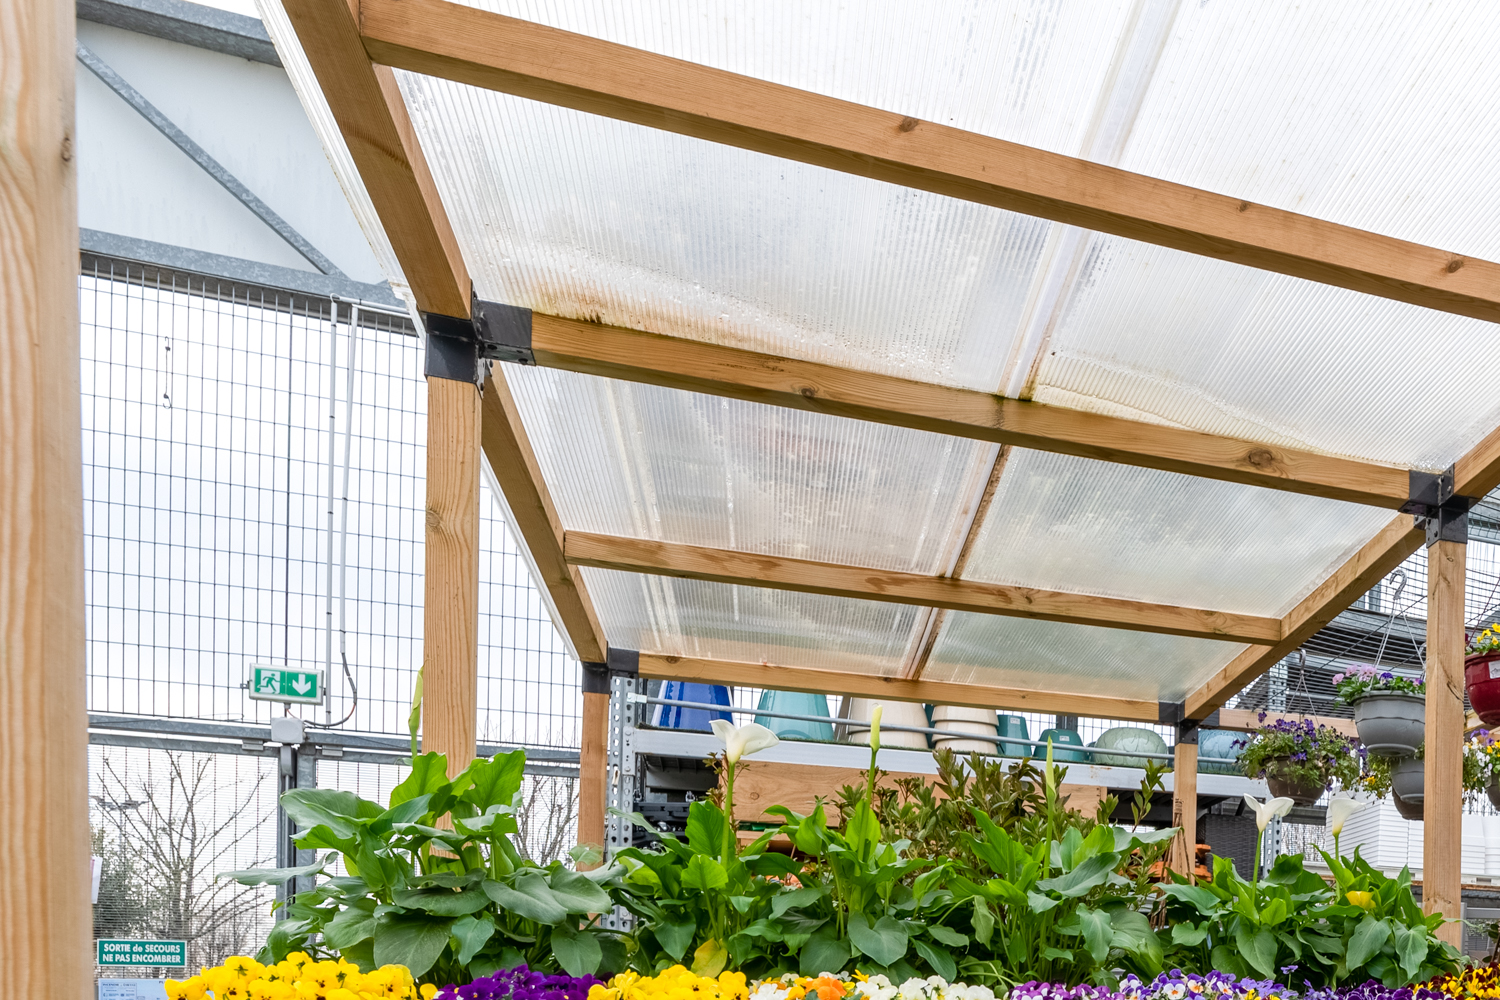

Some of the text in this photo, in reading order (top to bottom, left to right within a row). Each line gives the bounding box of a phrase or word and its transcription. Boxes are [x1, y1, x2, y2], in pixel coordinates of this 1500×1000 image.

[104, 943, 180, 953] SORTIE de SECOURS
[103, 954, 181, 963] NE PAS ENCOMBRER
